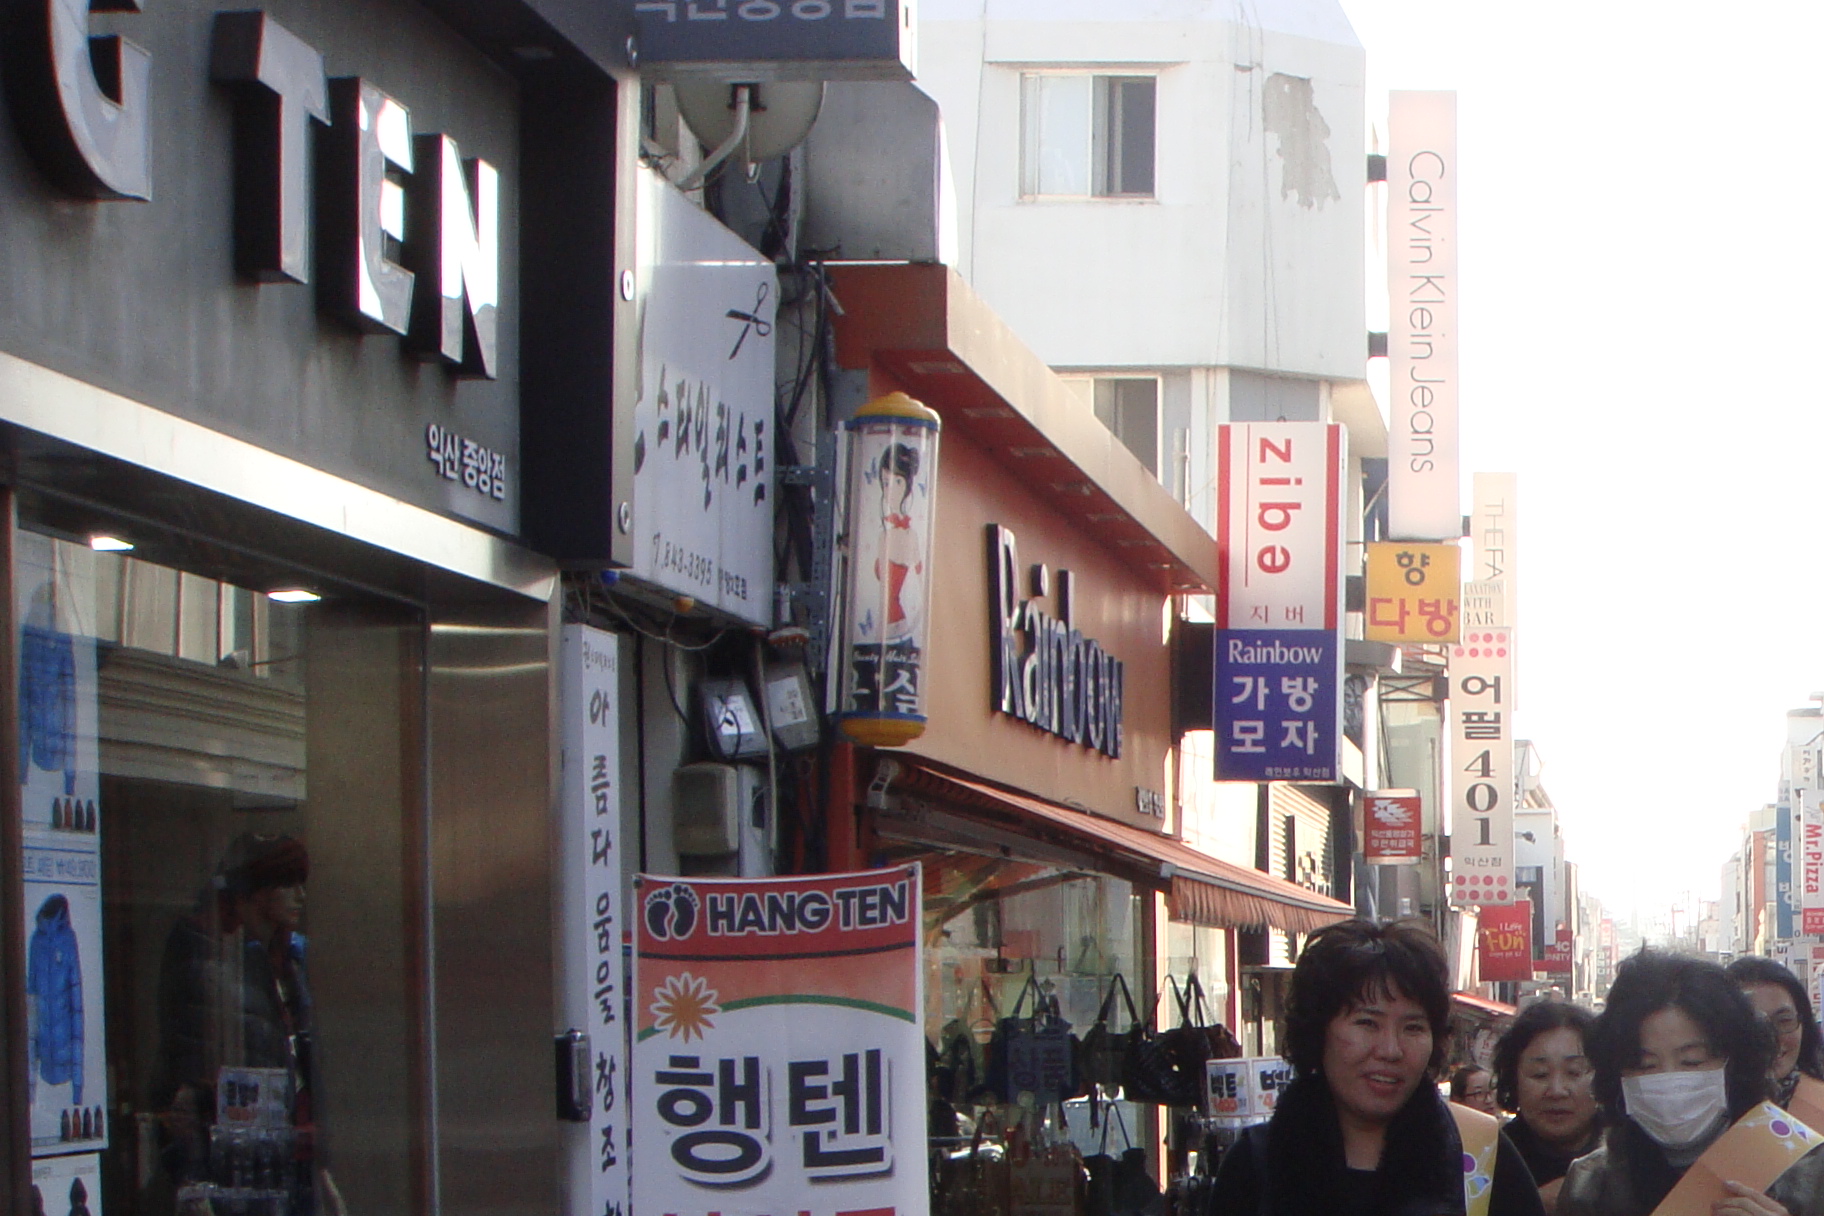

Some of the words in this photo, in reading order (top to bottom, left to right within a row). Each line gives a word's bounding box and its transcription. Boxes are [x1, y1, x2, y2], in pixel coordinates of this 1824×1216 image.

[240, 10, 499, 379] TEN
[1408, 151, 1445, 263] Calvin
[1409, 275, 1446, 360] Klein
[1410, 366, 1446, 473] Jeans
[427, 423, 460, 480] 익산
[462, 437, 507, 500] 중앙점
[1228, 638, 1322, 666] Rainbow
[1368, 597, 1458, 638] 다방
[1231, 675, 1317, 713] 가방
[1231, 719, 1318, 755] 모자
[1805, 823, 1823, 895] Mr.Pizza
[707, 889, 832, 936] HANG
[833, 881, 908, 932] TEN
[654, 1049, 887, 1176] 행텐
